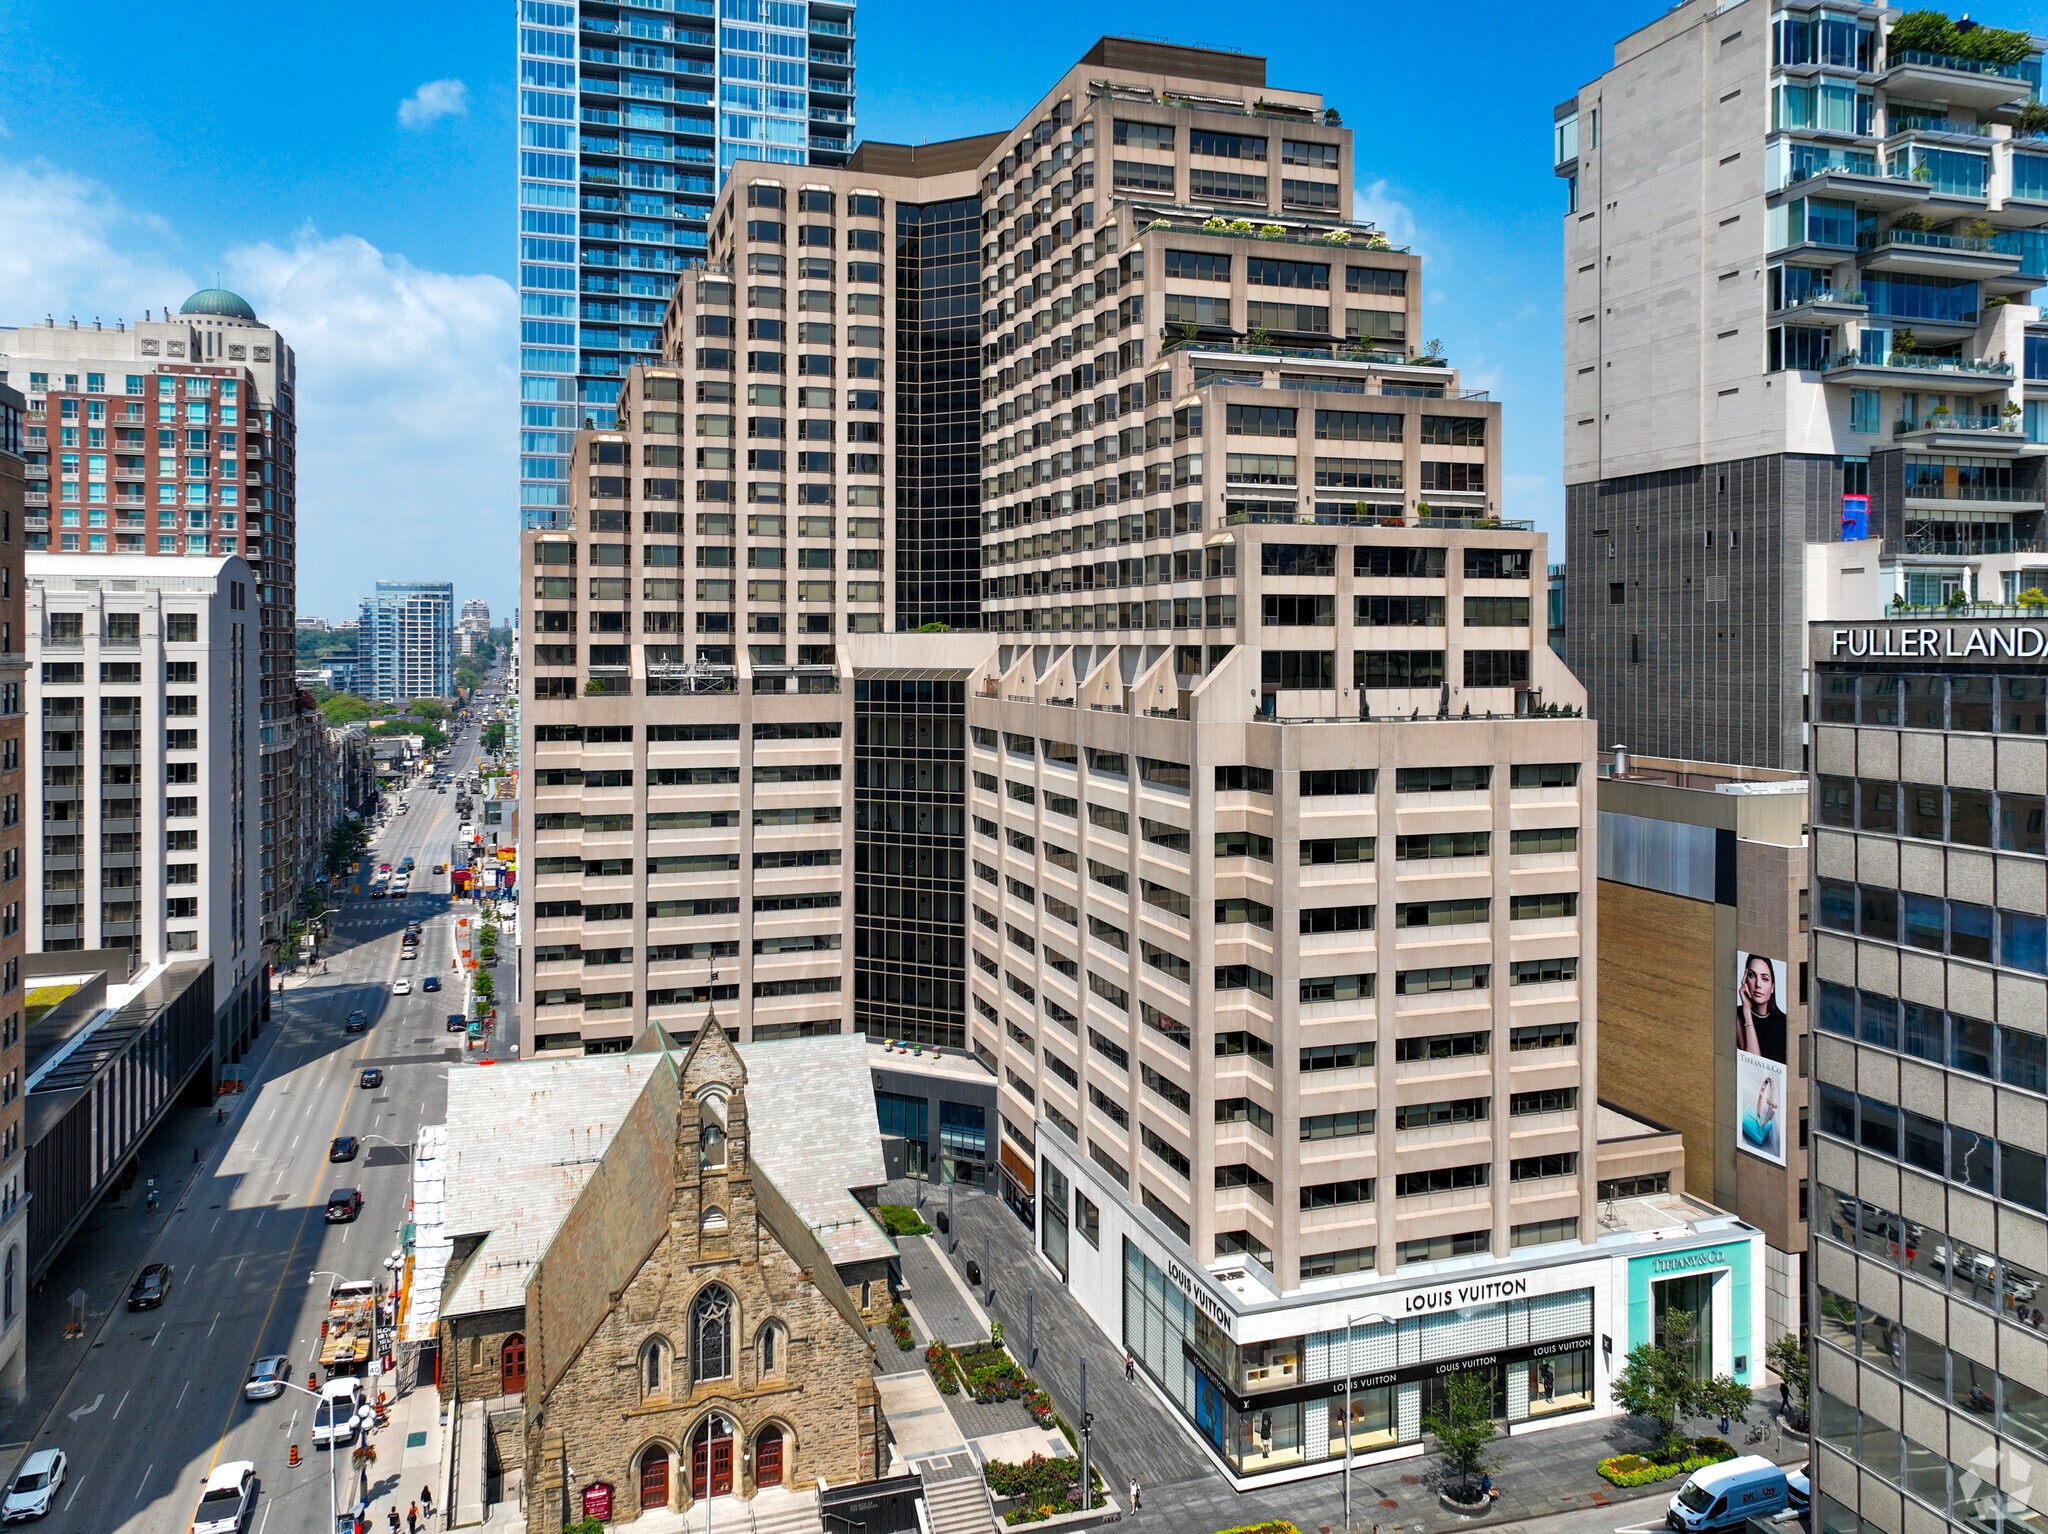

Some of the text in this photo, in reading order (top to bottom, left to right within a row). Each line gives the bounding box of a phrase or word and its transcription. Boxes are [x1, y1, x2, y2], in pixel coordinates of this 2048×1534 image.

[1832, 627, 2048, 657] FULLER LAND
[1168, 1260, 1231, 1332] LOUIS VUITTON
[1406, 1278, 1526, 1312] LOUIS VUITTON
[1533, 1339, 1591, 1356] LOUIS VUITTON
[1436, 1356, 1497, 1374] LOUIS VUITTON
[1207, 1369, 1226, 1395] VUITTON
[1360, 1374, 1397, 1387] VUITTON
